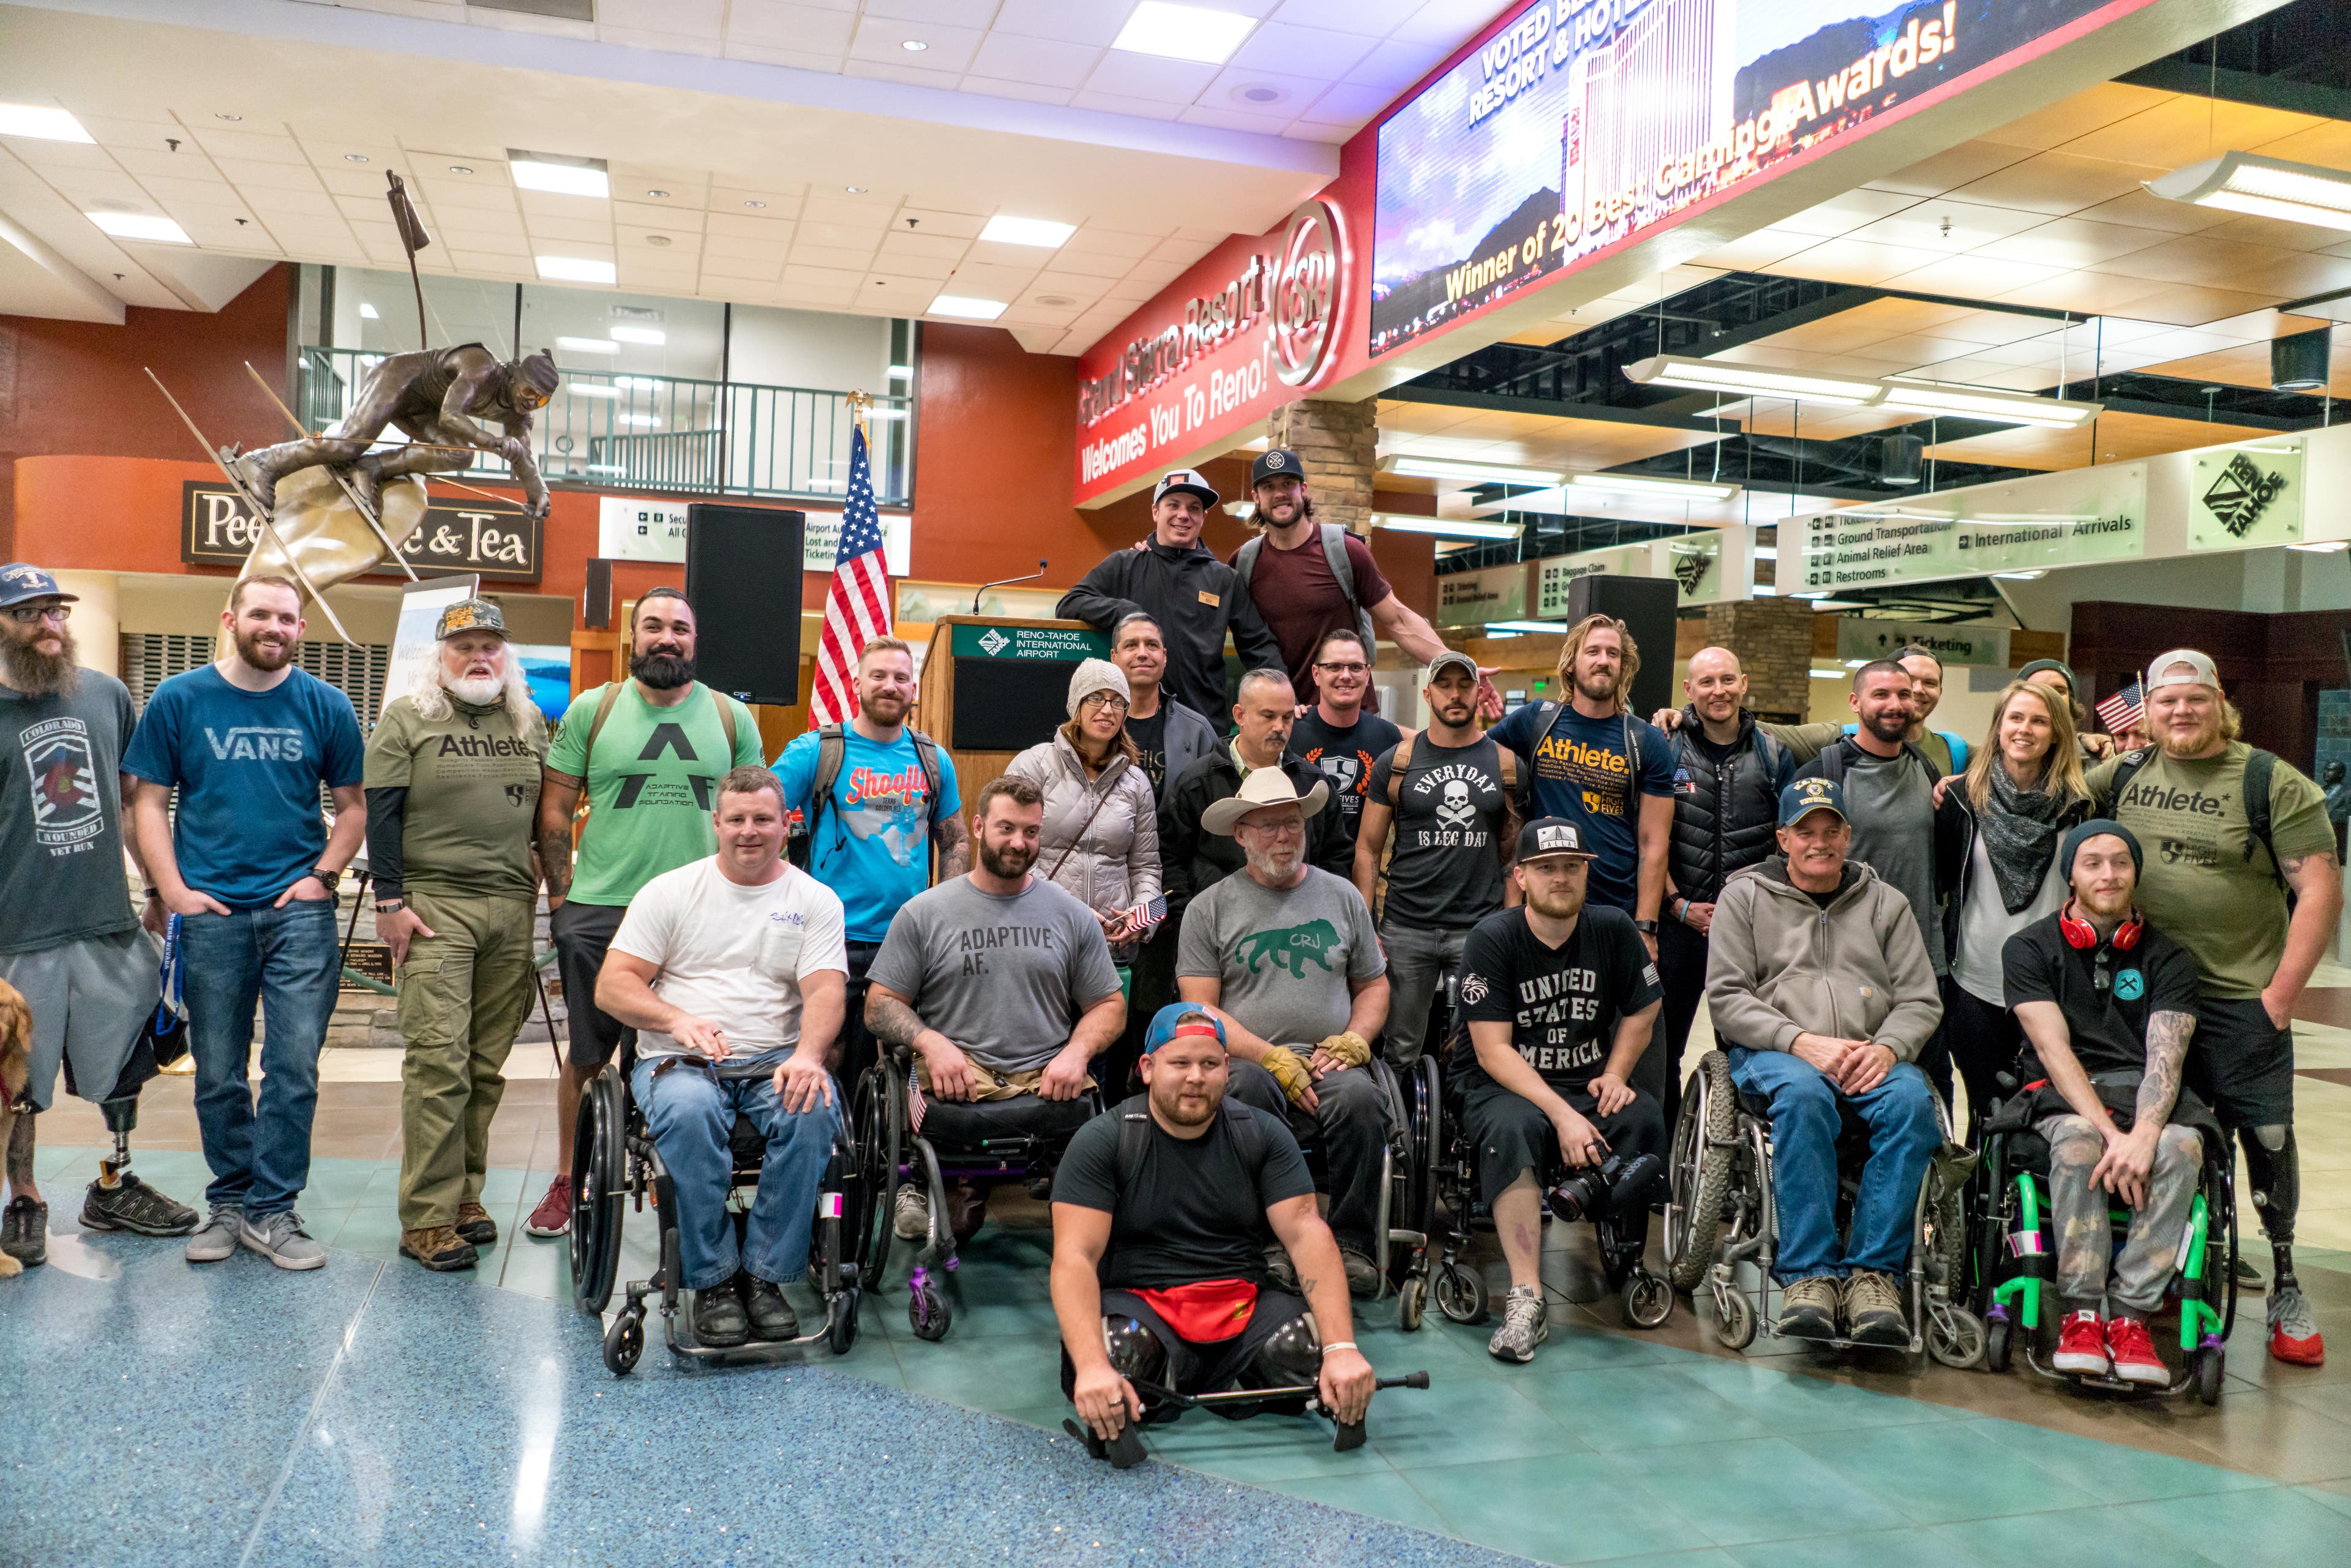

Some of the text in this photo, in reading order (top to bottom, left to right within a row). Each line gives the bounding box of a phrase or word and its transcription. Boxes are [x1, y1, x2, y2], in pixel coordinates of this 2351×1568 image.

[1482, 6, 1551, 80] VOTED
[1469, 38, 1550, 126] RESORT
[1553, 28, 1569, 66] &
[1445, 0, 1957, 304] Winner of 20 Best Gaming Awards!
[1278, 250, 1325, 336] GSR
[1079, 254, 1264, 426] Grand Sierra Resort
[1082, 340, 1270, 484] Welcomes You To Reno!
[2226, 471, 2285, 538] TAHOE
[429, 525, 463, 554] &
[457, 512, 527, 565] Tea
[669, 527, 681, 538] All
[806, 522, 831, 535] Airport
[1838, 520, 1952, 545] Ground Transportation
[1975, 515, 2131, 547] International Arrivals
[806, 536, 838, 547] Lost and
[1837, 542, 1928, 565] Animal Relief Area
[1562, 563, 1605, 578] Baggage Claim
[1836, 568, 1886, 583] Restrooms
[446, 606, 473, 620] HIGH
[446, 615, 473, 629] FIVES
[1016, 631, 1080, 641] RENO-TAHOE
[1016, 640, 1092, 651] INTERNATIONAL
[1912, 635, 1972, 656] Ticketing
[1016, 649, 1059, 658] AIRPORT
[25, 720, 82, 740] COLORADO
[205, 727, 303, 761] VANS
[846, 765, 929, 806] Shoofly
[1413, 764, 1496, 795] EVERYDAY
[1602, 796, 1623, 806] HIGH
[1602, 804, 1624, 814] FIVES
[43, 823, 97, 842] WOUNDED
[1418, 831, 1488, 847] IS LEG DAY
[50, 841, 94, 857] VET RUN
[1540, 841, 1577, 849] DALLAS
[2186, 844, 2217, 857] HIGH
[2184, 855, 2217, 865] FIVES
[961, 926, 1052, 952] ADAPTIVE
[962, 952, 989, 977] AF.
[1519, 968, 1597, 1004] UNITED
[1517, 997, 1599, 1027] STATES
[1547, 1028, 1567, 1044] OF
[1518, 1037, 1602, 1070] MERICA
